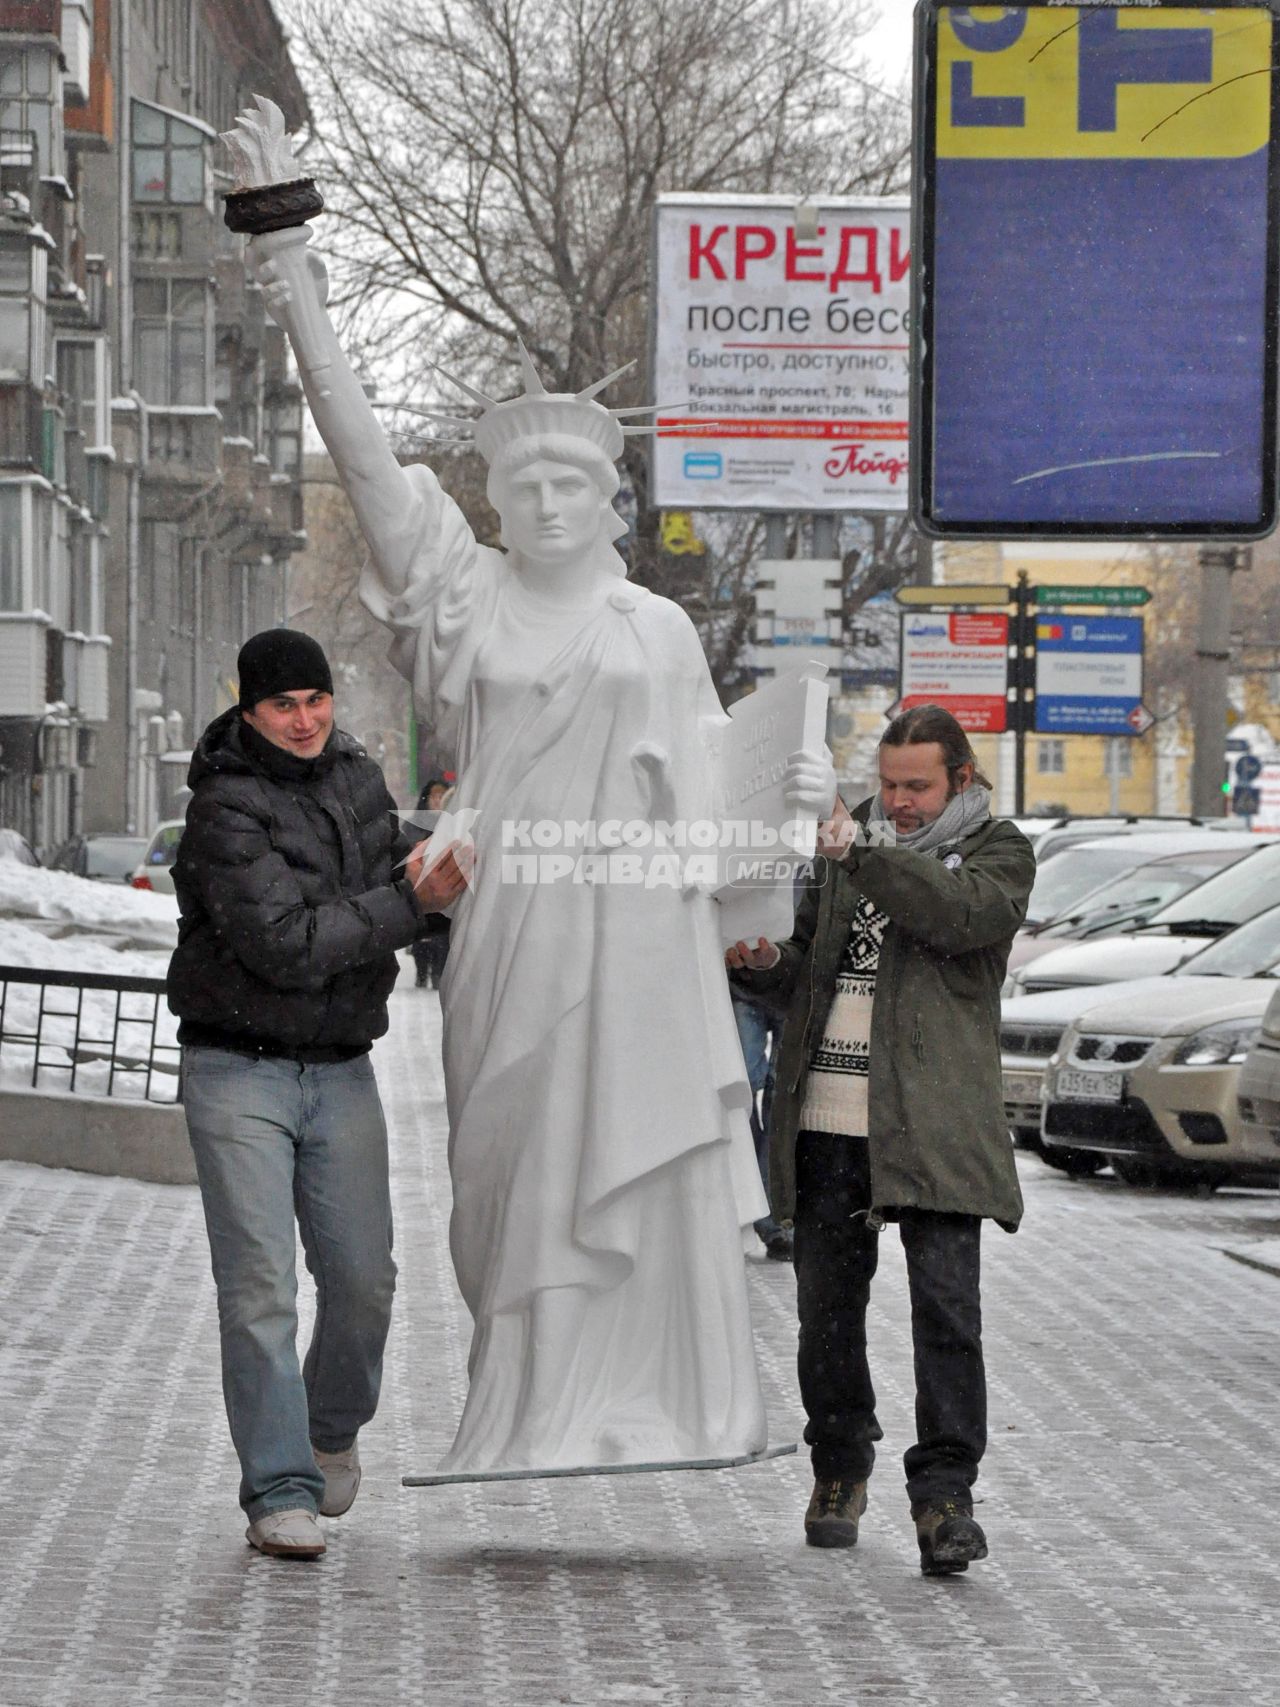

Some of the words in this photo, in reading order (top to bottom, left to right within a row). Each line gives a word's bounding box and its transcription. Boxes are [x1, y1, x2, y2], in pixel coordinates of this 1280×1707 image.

[688, 306, 811, 333] после
[687, 347, 775, 373] быстро,
[782, 352, 895, 375] доступно,
[689, 384, 754, 398] Красный
[688, 401, 777, 414] Вокзальная
